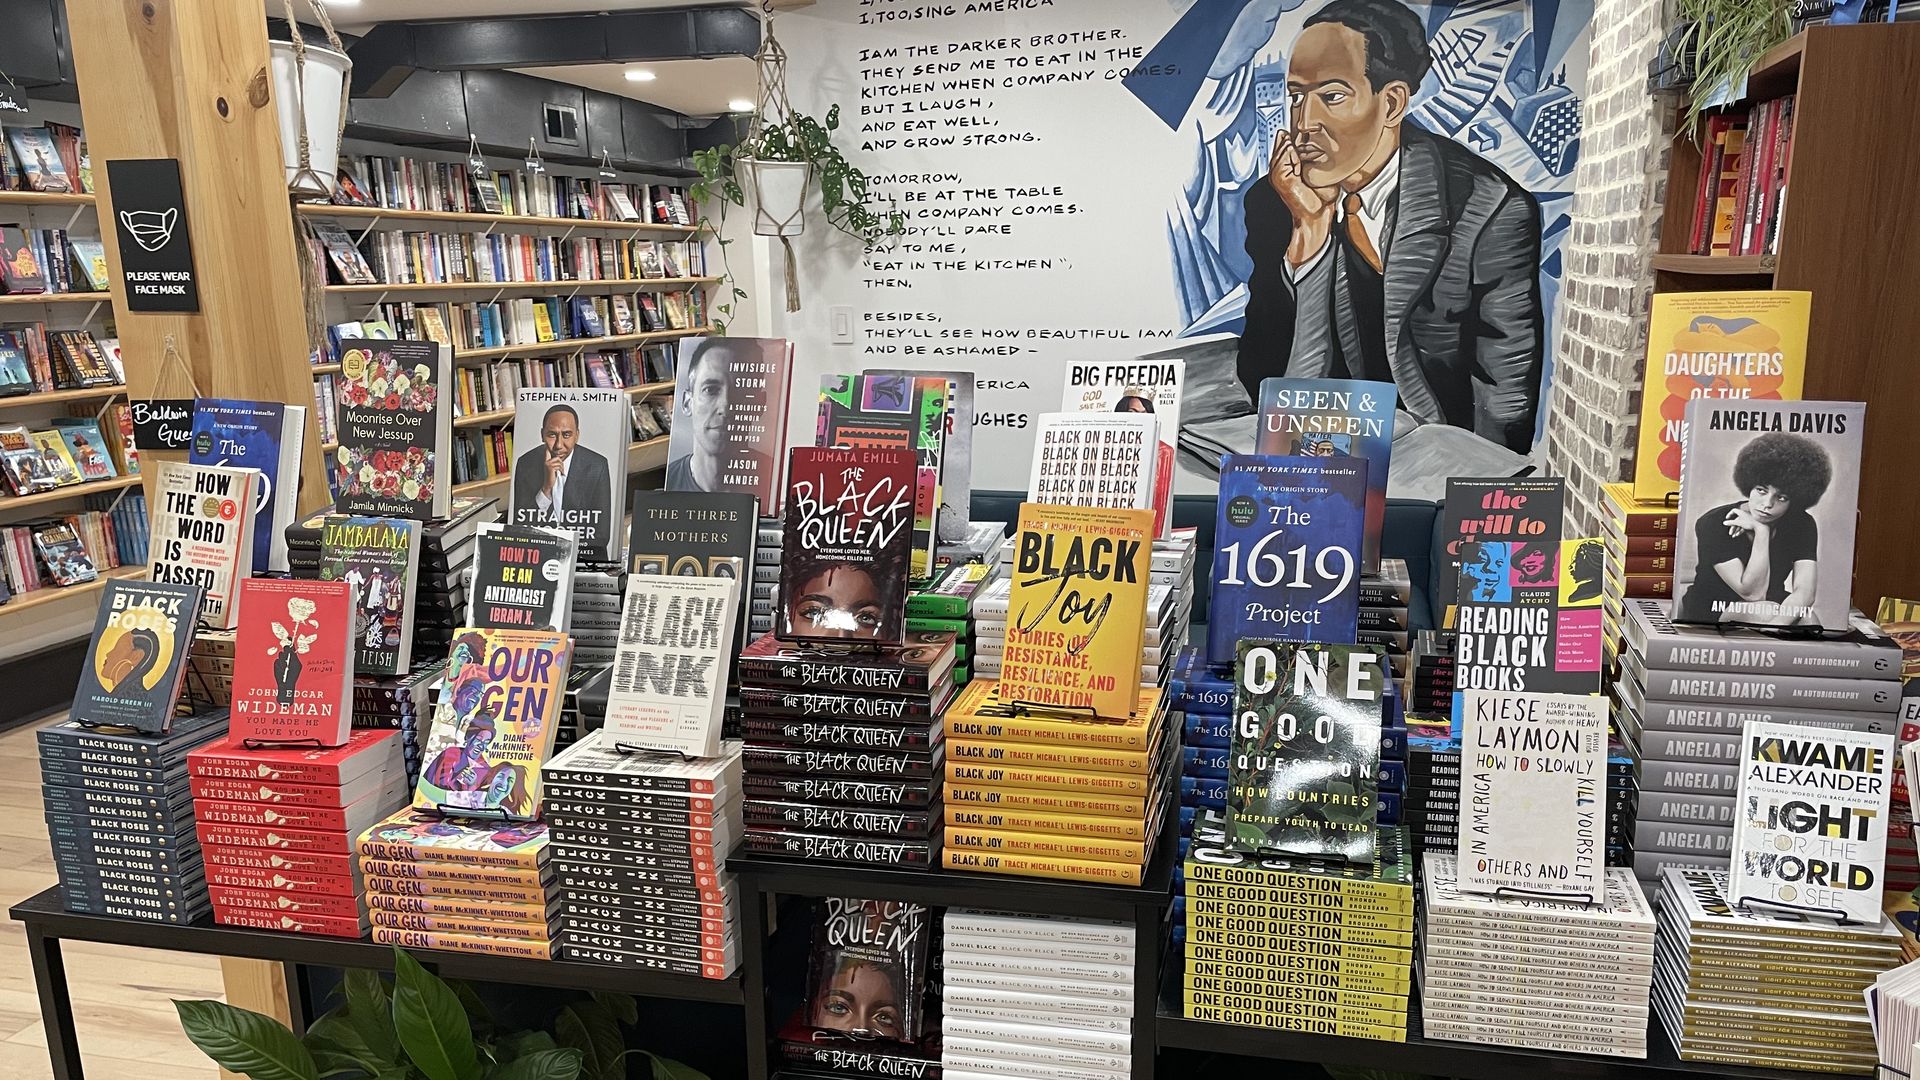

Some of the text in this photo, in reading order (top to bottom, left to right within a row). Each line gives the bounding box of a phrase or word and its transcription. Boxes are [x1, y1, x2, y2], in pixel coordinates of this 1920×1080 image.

[904, 29, 1127, 58] THE DARKER BROTHER.
[860, 46, 1143, 81] THEY SEND THE
[861, 70, 1095, 100] KITCHEN WHEN COMPANY
[861, 103, 895, 116] BUT
[861, 115, 999, 133] AND EAT WELL,
[861, 131, 1041, 152] AND GROW STRONG.
[962, 186, 1064, 202] THE TABLE
[917, 203, 1084, 220] COMPANY COMES.
[964, 224, 1011, 235] DARE
[932, 259, 1052, 271] THE KITCHEN
[126, 272, 190, 281] PLEASE WEAR
[863, 278, 912, 289] THEN.
[135, 285, 185, 294] FACE MASK
[863, 312, 942, 323] BESIDES,
[940, 329, 1130, 340] SEE HOW BEAUTIFUL
[864, 345, 1020, 356] AND ASHAMED
[729, 363, 776, 373] INVISIBLE
[1664, 352, 1784, 376] DAUGHTERS
[735, 378, 766, 388] STORM
[1071, 365, 1176, 386] BIG FREEDIA
[520, 393, 617, 402] STEPHEN SMITH
[1276, 390, 1376, 412] SEEN &
[132, 404, 188, 424] Baldwin
[346, 411, 422, 426] Moonrise Over
[1710, 410, 1846, 434] ANGELA DAVIS
[353, 426, 414, 443] New Jessup
[1266, 414, 1384, 438] UNSEEN
[1045, 431, 1143, 444] BLACK ON BLACK
[219, 440, 246, 456] The
[810, 451, 899, 464] JUMATA EMILL
[728, 460, 757, 470] JASON
[195, 472, 231, 496] HOW
[723, 475, 759, 486] KANDER
[840, 467, 864, 484] THE
[167, 491, 196, 515] THE
[349, 501, 414, 514] Jamila Minnicks
[793, 473, 910, 531] BLACK
[1482, 489, 1528, 510] the
[517, 509, 602, 524] STRAIGHT
[648, 509, 738, 521] THE THREE
[1232, 506, 1253, 514] hulu
[1268, 506, 1311, 526] The
[178, 518, 224, 543] WORD
[800, 512, 907, 549] QUEEN
[1460, 514, 1546, 535] will to
[326, 525, 408, 549] JAMBALAYA
[653, 531, 728, 543] MOTHERS
[164, 539, 181, 561] IS
[500, 546, 540, 564] HOW TO
[1018, 531, 1140, 583] BLACK
[502, 567, 532, 584] BE AN
[1219, 529, 1354, 605] 1619
[112, 593, 182, 615] BLACK
[484, 587, 546, 605] ANTIRACIST
[1246, 603, 1321, 628] Project
[1728, 602, 1814, 618] AUTOBIOGRAPHY
[107, 612, 177, 633] ROSES
[1459, 606, 1549, 635] READING
[362, 651, 393, 666] TEISH
[1458, 634, 1548, 668] BLACK
[1669, 648, 1860, 668] ANGELA DAVIS AUTOBIOGRAPHY
[488, 646, 554, 683] OUR
[1244, 647, 1377, 700] ONE
[780, 666, 904, 689] THE QUEEN
[1087, 674, 1115, 692] AND
[1457, 665, 1525, 691] BOOKS
[249, 688, 278, 696] JOHN
[1001, 684, 1093, 707] RESTORATION
[238, 701, 333, 716] WIDEMAN
[480, 686, 547, 722] GEN
[1477, 697, 1540, 722] KIESE
[503, 734, 526, 742] DIANE
[953, 723, 1122, 743] BLACK JOY TRACEY LEWIS-GIGGETTS
[1477, 727, 1579, 753] LAYMON
[78, 739, 133, 752] BLACK ROSES
[1752, 736, 1883, 774] KWAME
[488, 752, 533, 761] WHETSTONE
[1477, 754, 1593, 775] HOW TO SLOWLY
[197, 766, 257, 778] WIDEMAN
[550, 772, 651, 786] BLACK INK
[1751, 764, 1882, 795] ALEXANDER
[1576, 778, 1595, 806] KILL
[1473, 773, 1492, 835] AMERICA
[1234, 814, 1318, 828] PREPARE YOUTH
[1748, 796, 1877, 841] LIGHT
[362, 843, 414, 860] OUR GEN
[1575, 812, 1594, 882] YOURSELF
[1194, 865, 1341, 892] ONE GOOD QUESTION
[1477, 859, 1568, 879] OTHERS AND
[1744, 852, 1874, 891] WORLD
